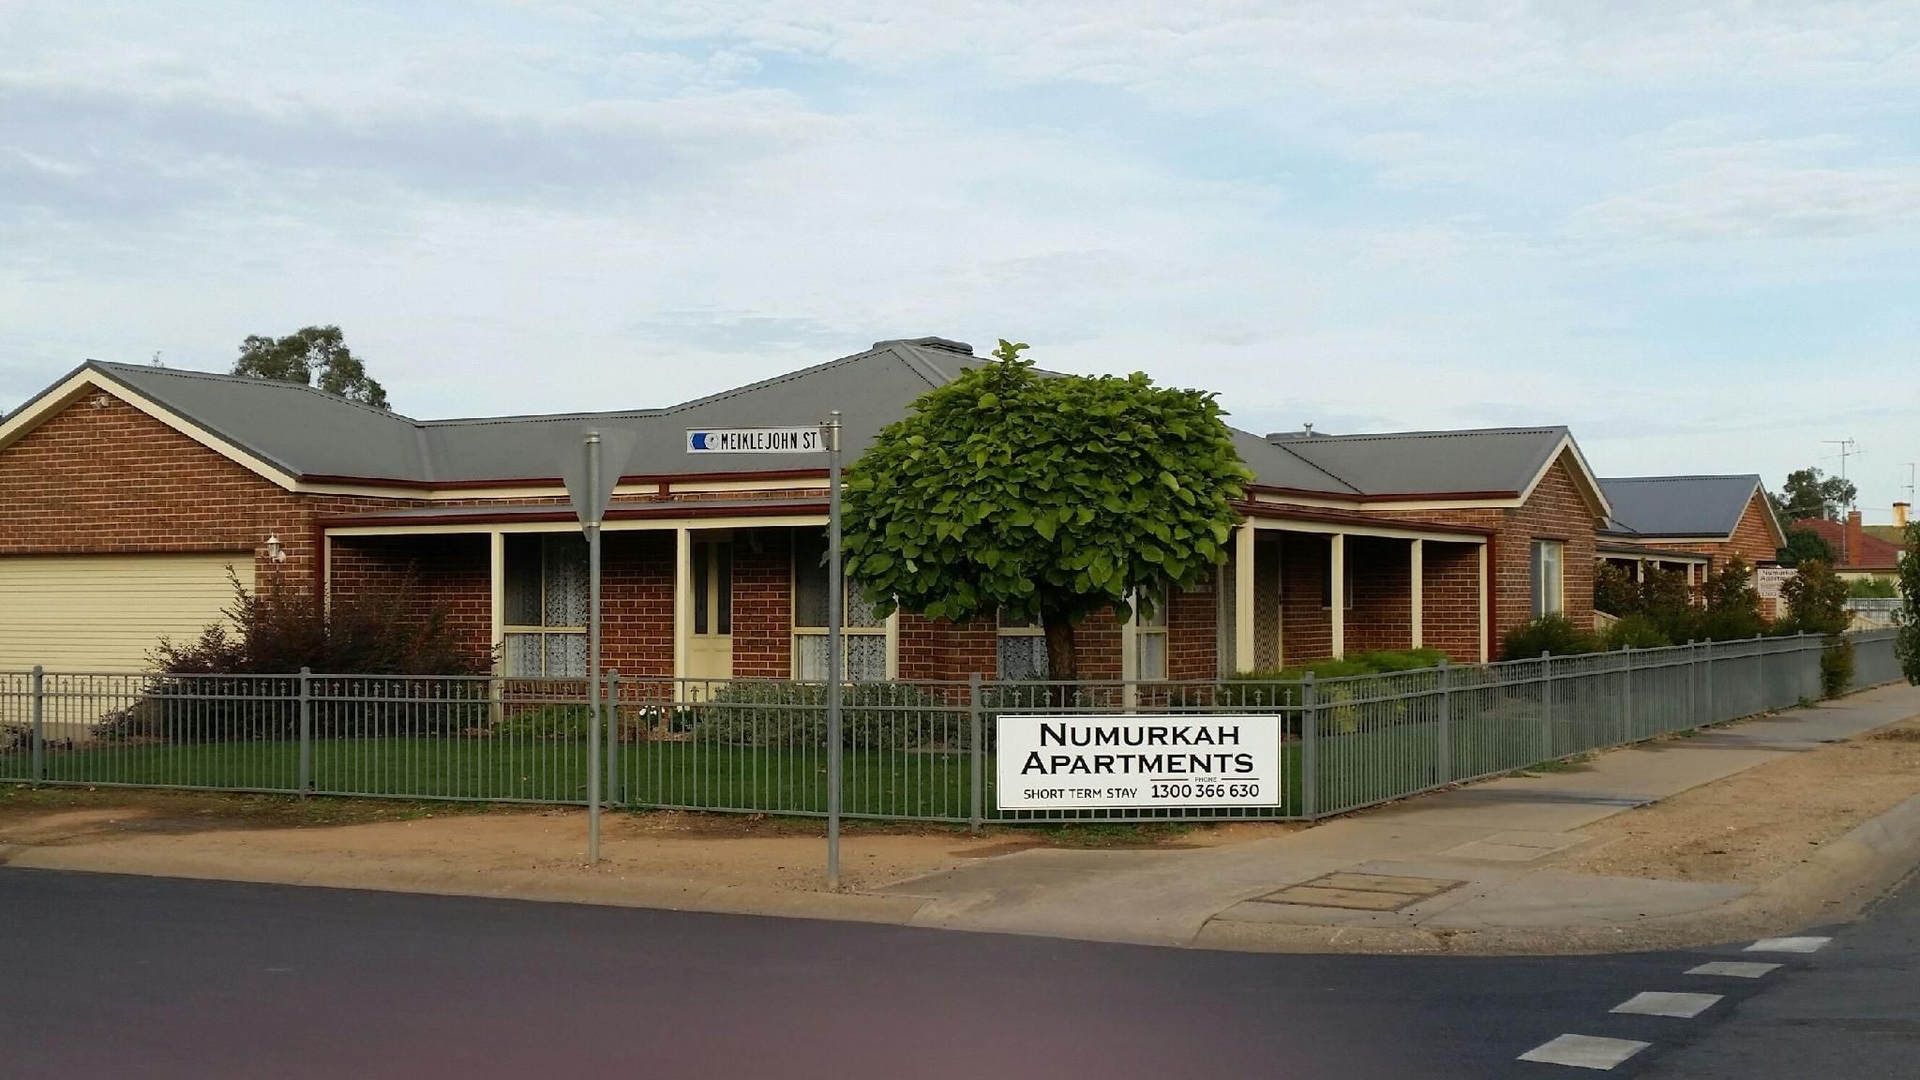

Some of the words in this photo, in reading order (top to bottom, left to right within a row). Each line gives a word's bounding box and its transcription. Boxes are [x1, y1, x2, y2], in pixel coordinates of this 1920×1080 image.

[721, 431, 798, 451] MEIKLEJOHN
[802, 431, 818, 450] ST
[1040, 722, 1240, 747] NUMURKAH
[1020, 751, 1254, 775] APARTMENTS
[1023, 788, 1065, 800] SHORT
[1068, 788, 1102, 799] TERM
[1106, 787, 1138, 799] STAY
[1151, 784, 1192, 799] 1300
[1195, 784, 1226, 798] 366
[1229, 784, 1260, 798] 630
